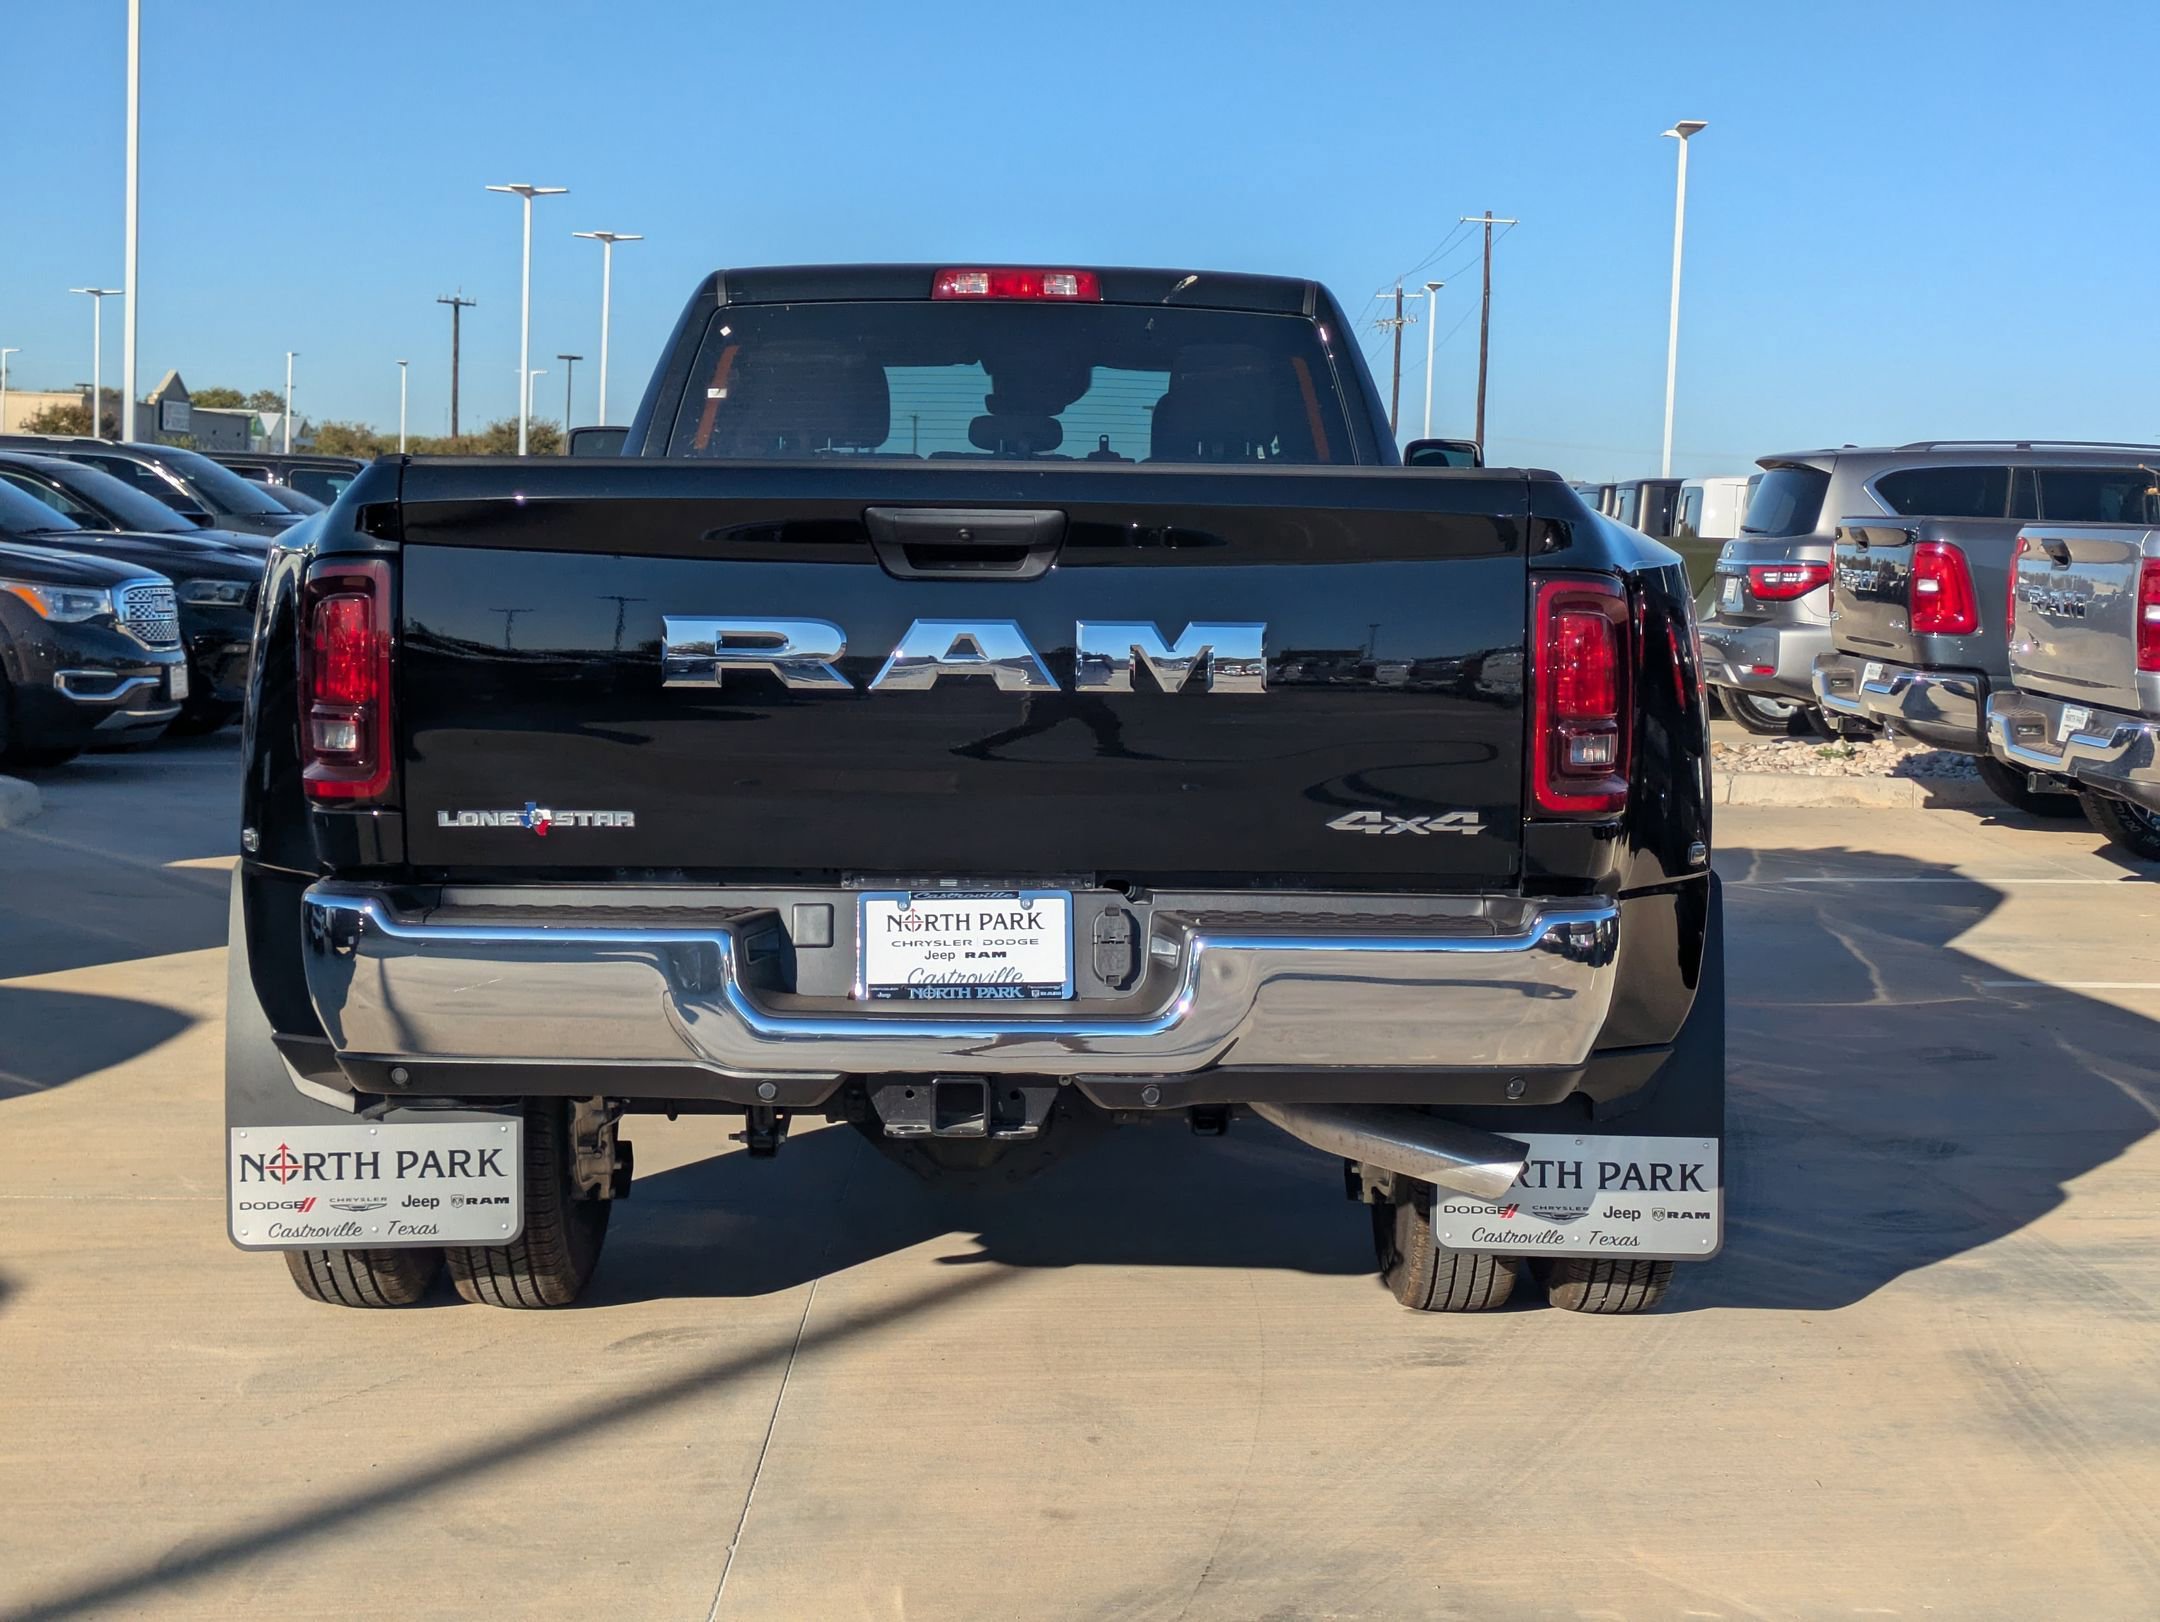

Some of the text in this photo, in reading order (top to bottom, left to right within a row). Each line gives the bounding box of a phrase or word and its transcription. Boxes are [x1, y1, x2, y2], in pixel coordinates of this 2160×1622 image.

[661, 615, 1269, 694] RAM
[437, 810, 636, 828] LONE STAR
[913, 891, 1016, 900] Castroville
[886, 911, 1046, 932] NORTH PARK
[891, 938, 1039, 948] CHRYSLER DODGE
[924, 950, 1007, 961] Jeep RAM
[907, 966, 1024, 984] Castroville
[908, 986, 972, 1000] NORTH
[974, 986, 1025, 999] PARK
[239, 1148, 509, 1184] NORTH PARK
[1598, 1161, 1709, 1193] PARK
[239, 1200, 306, 1210] DODGE
[401, 1194, 440, 1210] Jeep
[465, 1196, 510, 1205] RAM
[1444, 1204, 1508, 1215] DODGE
[1602, 1205, 1642, 1222] Jeep
[1667, 1211, 1711, 1219] RAM
[268, 1220, 440, 1238] Castroville Texas
[1472, 1227, 1641, 1247] Castroville Texas
